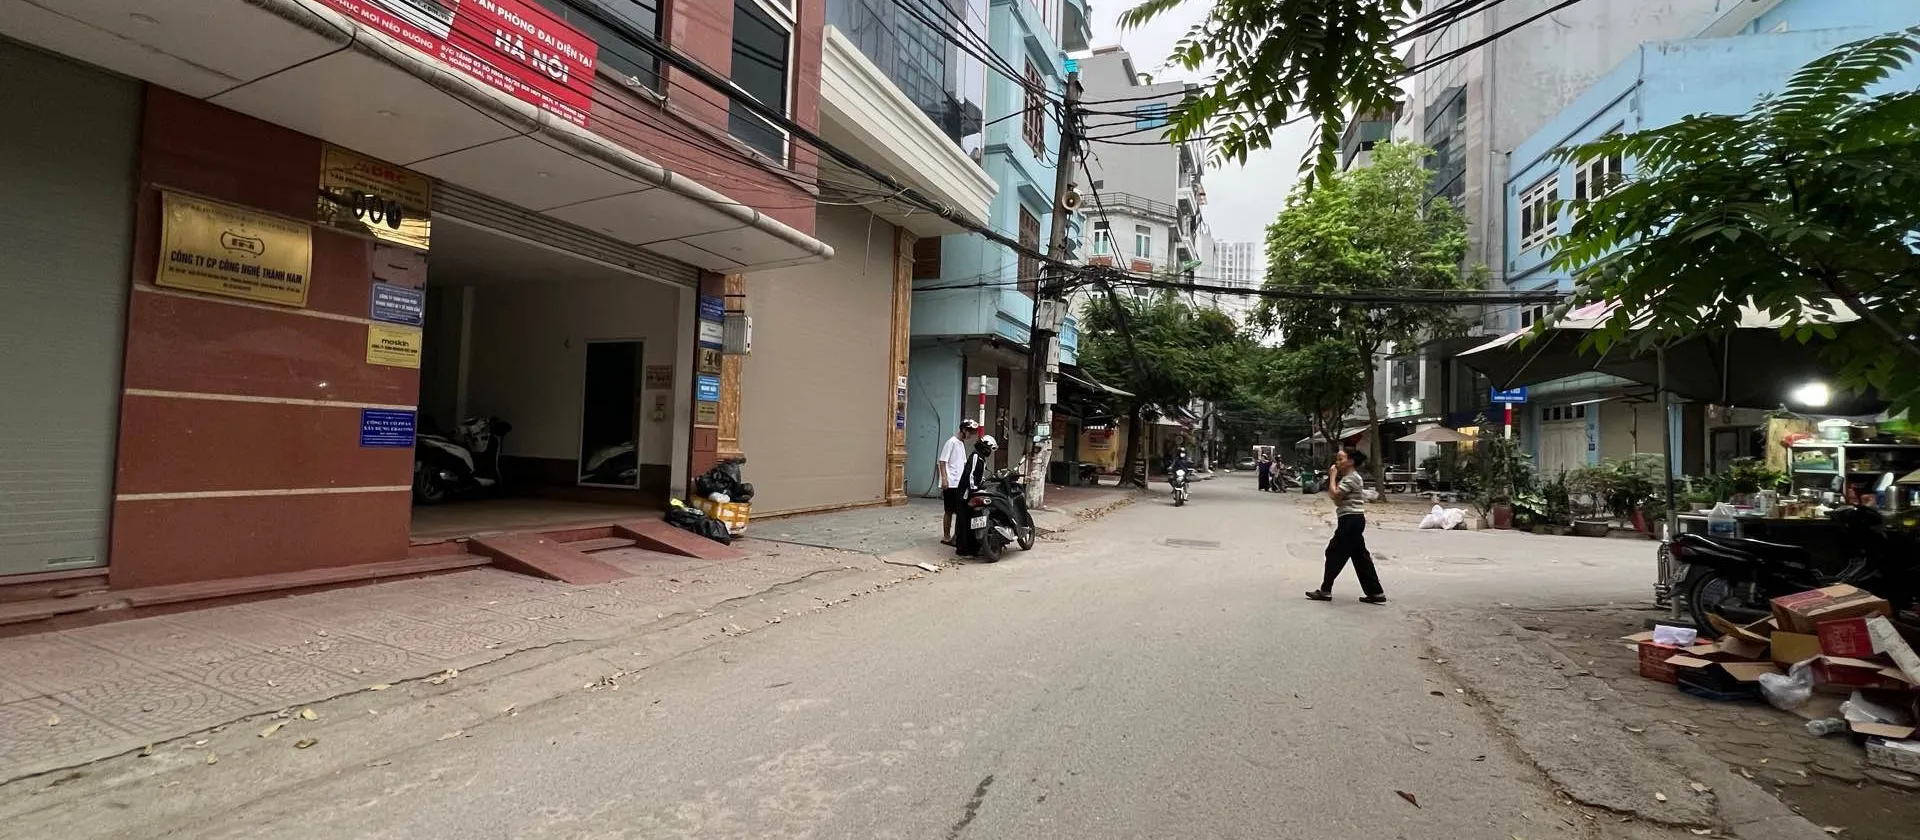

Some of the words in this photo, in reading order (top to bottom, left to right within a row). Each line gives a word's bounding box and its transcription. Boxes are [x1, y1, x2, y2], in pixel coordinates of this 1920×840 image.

[495, 28, 526, 61] HÀ
[532, 48, 569, 83] NỘI
[497, 6, 535, 34] PHÒNG
[538, 29, 554, 46] ĐẠI
[557, 41, 577, 59] DIỆN
[579, 52, 593, 68] TẠI
[171, 249, 193, 264] CÔNG
[196, 254, 204, 266] TY
[206, 257, 217, 269] CP
[219, 259, 240, 273] CÔNG
[241, 264, 260, 278] NGHỆ
[287, 272, 303, 285] NAM
[381, 339, 409, 347] moskin
